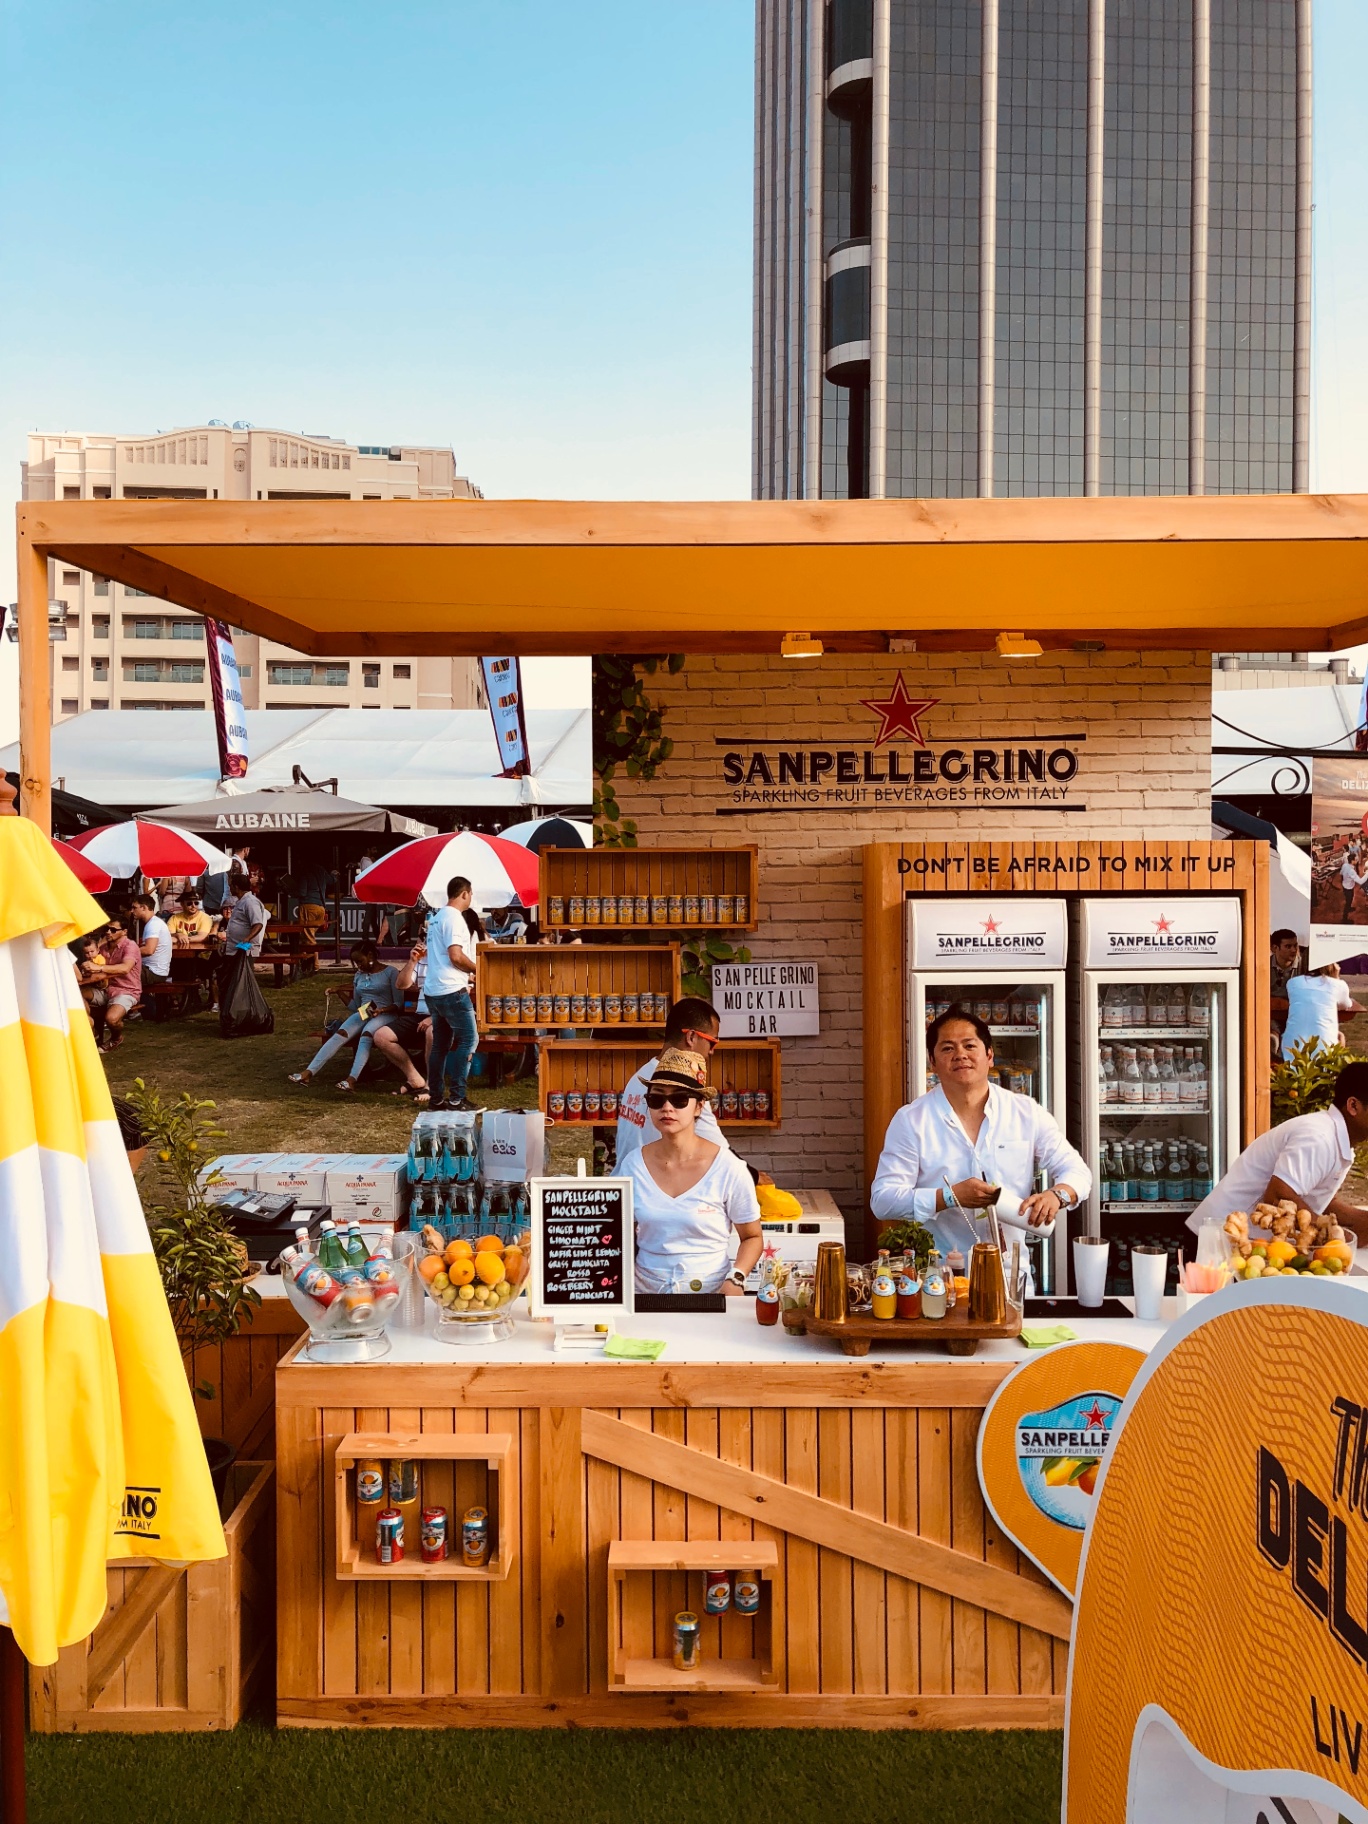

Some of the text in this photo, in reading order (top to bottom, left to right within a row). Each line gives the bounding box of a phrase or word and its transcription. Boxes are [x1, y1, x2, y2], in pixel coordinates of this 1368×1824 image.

[723, 749, 1078, 786] SANPELLEGRINO
[732, 786, 1069, 804] SPARKLING FRUIT BEVERAGES FROM ITALY
[215, 813, 310, 829] AUBAINE
[897, 856, 1236, 874] DON'T BE AFRAID TO MIX IT UP
[938, 936, 1044, 948] SANPELLEGRINO
[1110, 935, 1216, 947] SANPELLEGRINO
[724, 990, 805, 1010] MOCKTAIL
[748, 1015, 777, 1034] BAR
[545, 1190, 620, 1204] SANPELLEGRINO
[552, 1204, 608, 1217] MOCKTAILS
[548, 1224, 602, 1235] GINGER MINT
[549, 1236, 600, 1245] LIMONATA
[573, 1248, 593, 1258] LIME
[132, 1519, 152, 1530] ITALY
